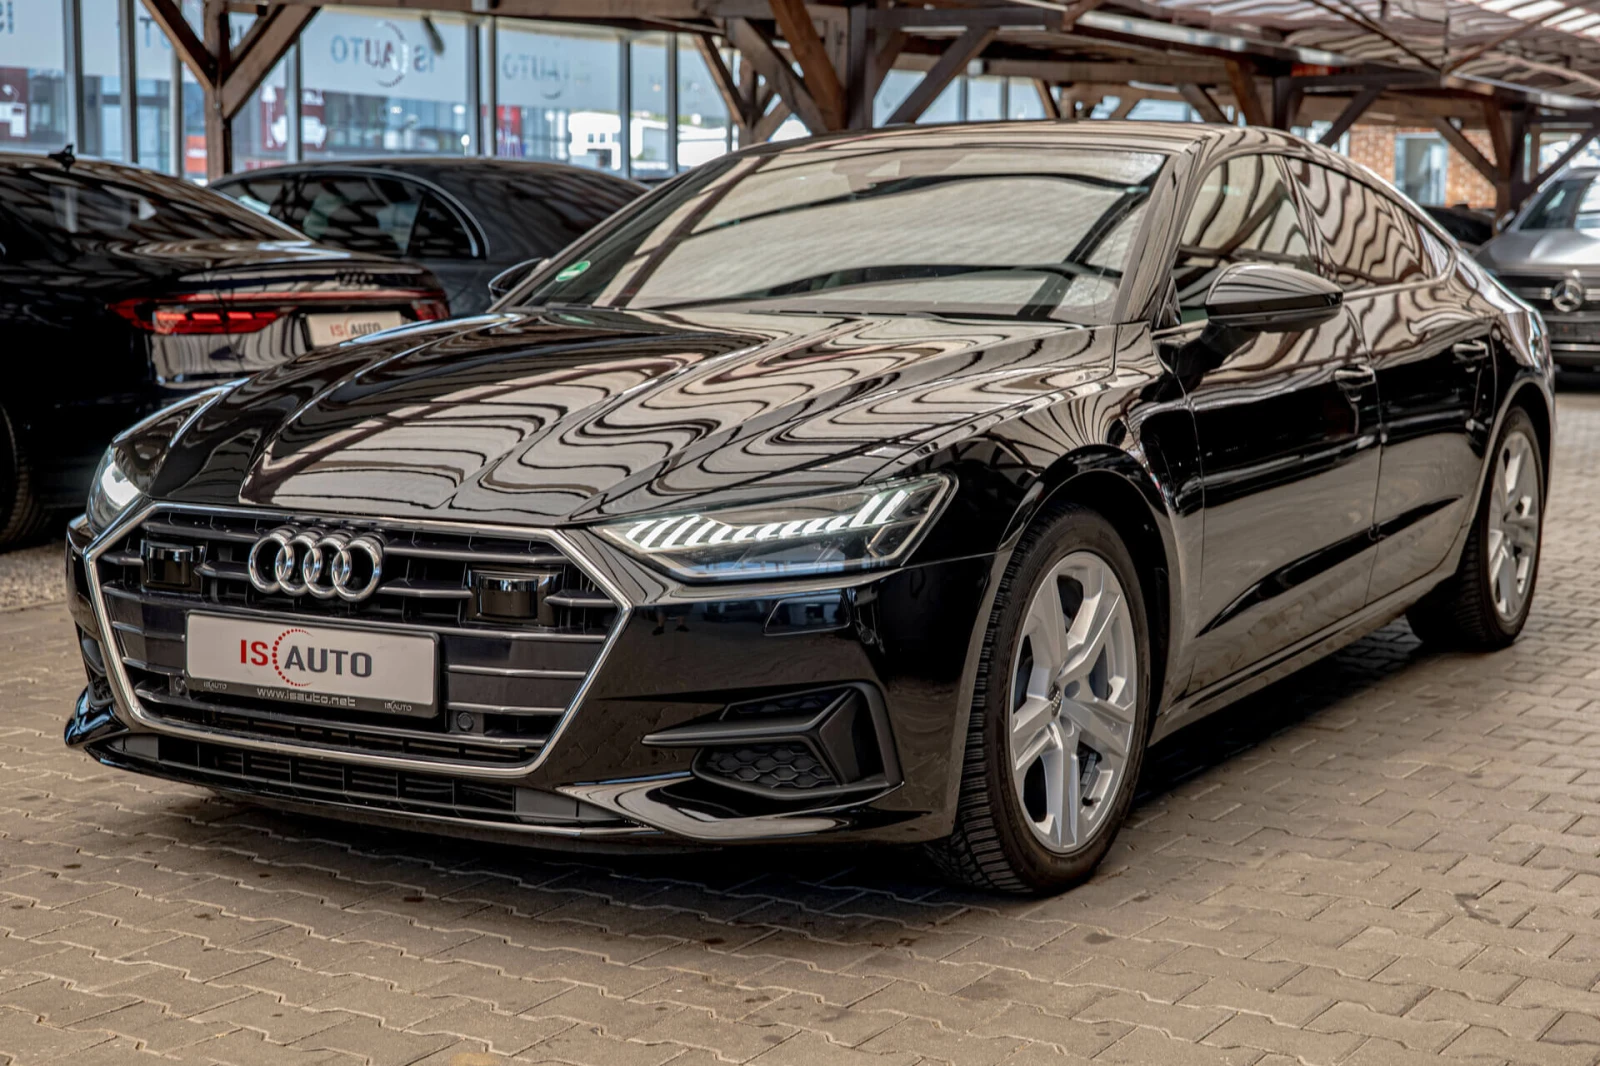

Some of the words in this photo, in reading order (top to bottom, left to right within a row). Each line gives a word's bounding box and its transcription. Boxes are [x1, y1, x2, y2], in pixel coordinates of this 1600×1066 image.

[240, 639, 269, 666] IS
[284, 645, 372, 678] AUTO
[256, 687, 356, 707] www.isauto.net
